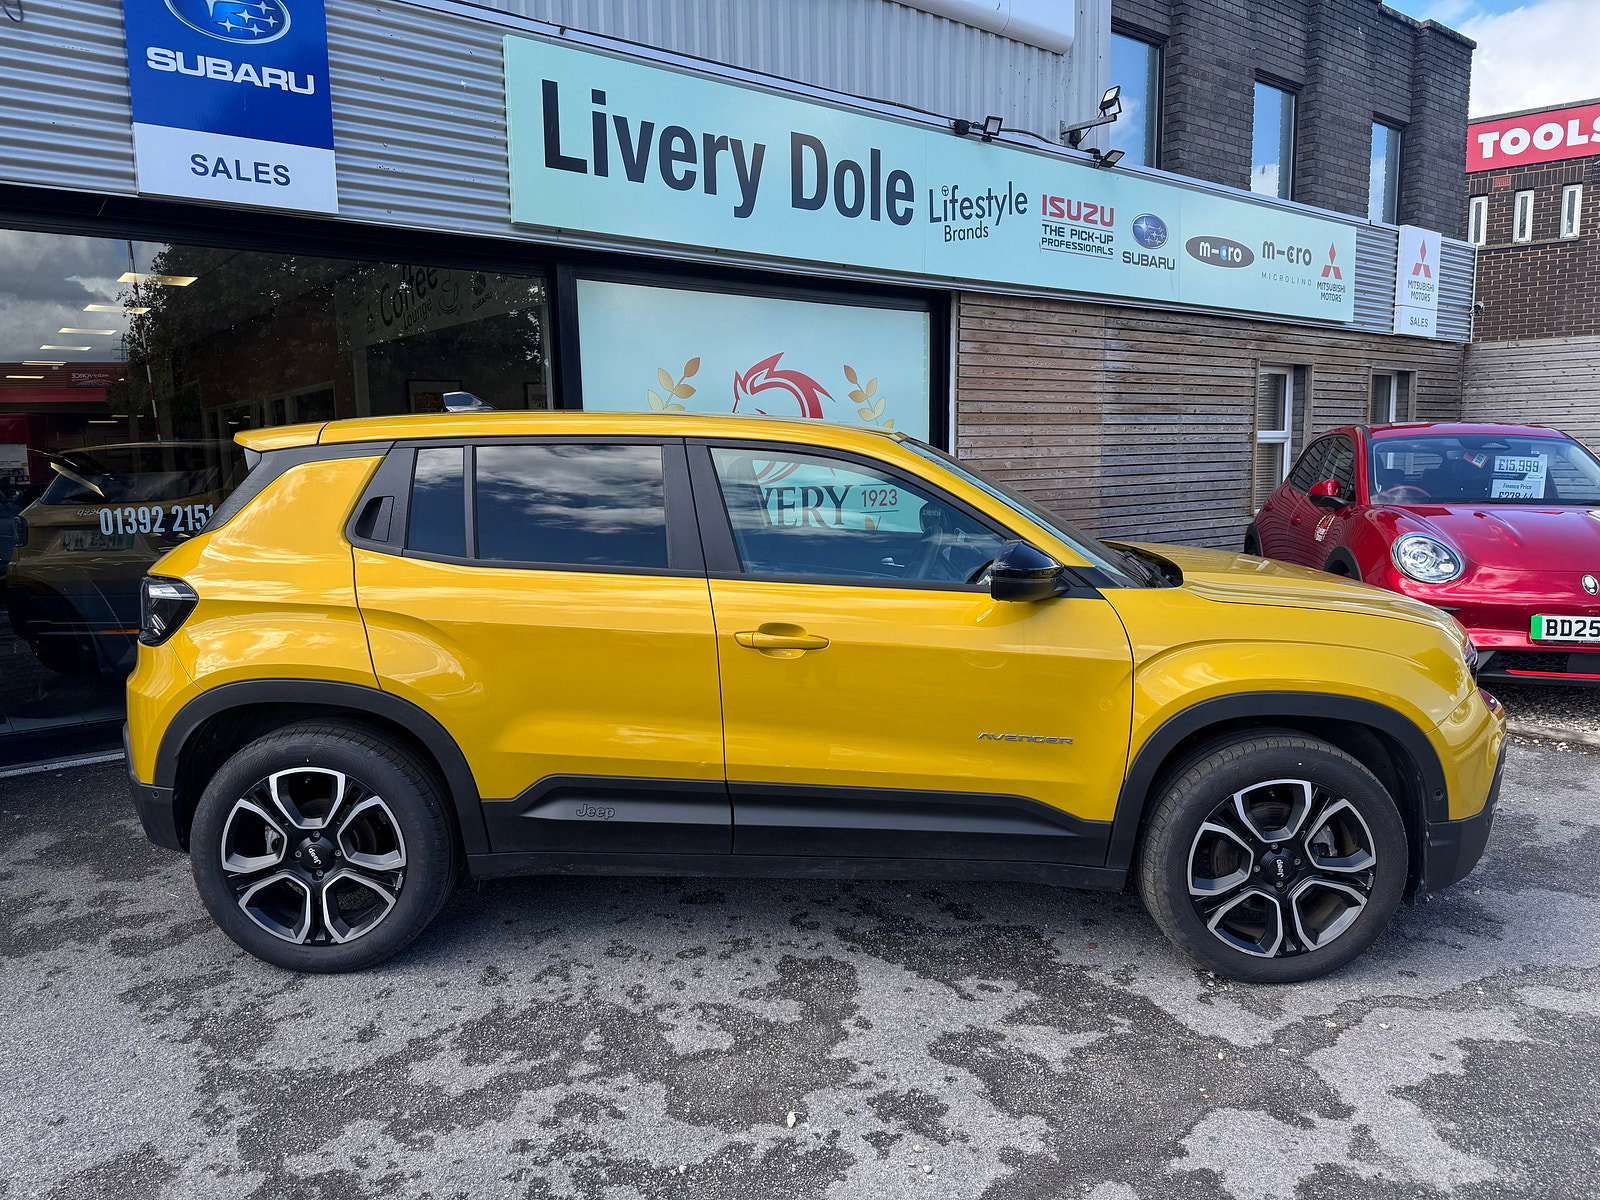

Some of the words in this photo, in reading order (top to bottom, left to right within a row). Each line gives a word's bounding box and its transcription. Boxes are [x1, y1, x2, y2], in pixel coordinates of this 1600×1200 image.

[146, 46, 315, 95] SUBARU
[541, 79, 766, 219] Livery
[790, 131, 915, 226] Dole
[190, 153, 291, 187] SALES
[929, 180, 1028, 226] Lifestyle
[1041, 194, 1115, 228] ISUZU
[944, 220, 989, 243] Brands
[1041, 223, 1066, 238] THE
[1070, 228, 1114, 245] PICK-UP
[1041, 237, 1114, 256] PROFESSIONALS
[1122, 251, 1176, 271] SUBARU
[1261, 272, 1313, 287] MICROLINO
[1316, 281, 1347, 294] MITSUBISHI
[1407, 279, 1436, 293] MITSUBISHI
[1320, 292, 1343, 303] MOTORS
[1410, 290, 1432, 303] MOTORS
[402, 298, 433, 331] Lounge
[1409, 316, 1430, 328] SALES
[1498, 459, 1540, 473] £15,999
[1503, 482, 1519, 490] Finance
[861, 488, 899, 508] 1923
[99, 506, 166, 536] 01392
[1545, 619, 1600, 637] BD25
[977, 732, 1074, 745] AVENGER
[576, 803, 615, 820] Jeep
[308, 847, 321, 865] Jeep
[1276, 859, 1284, 878] Jeep
